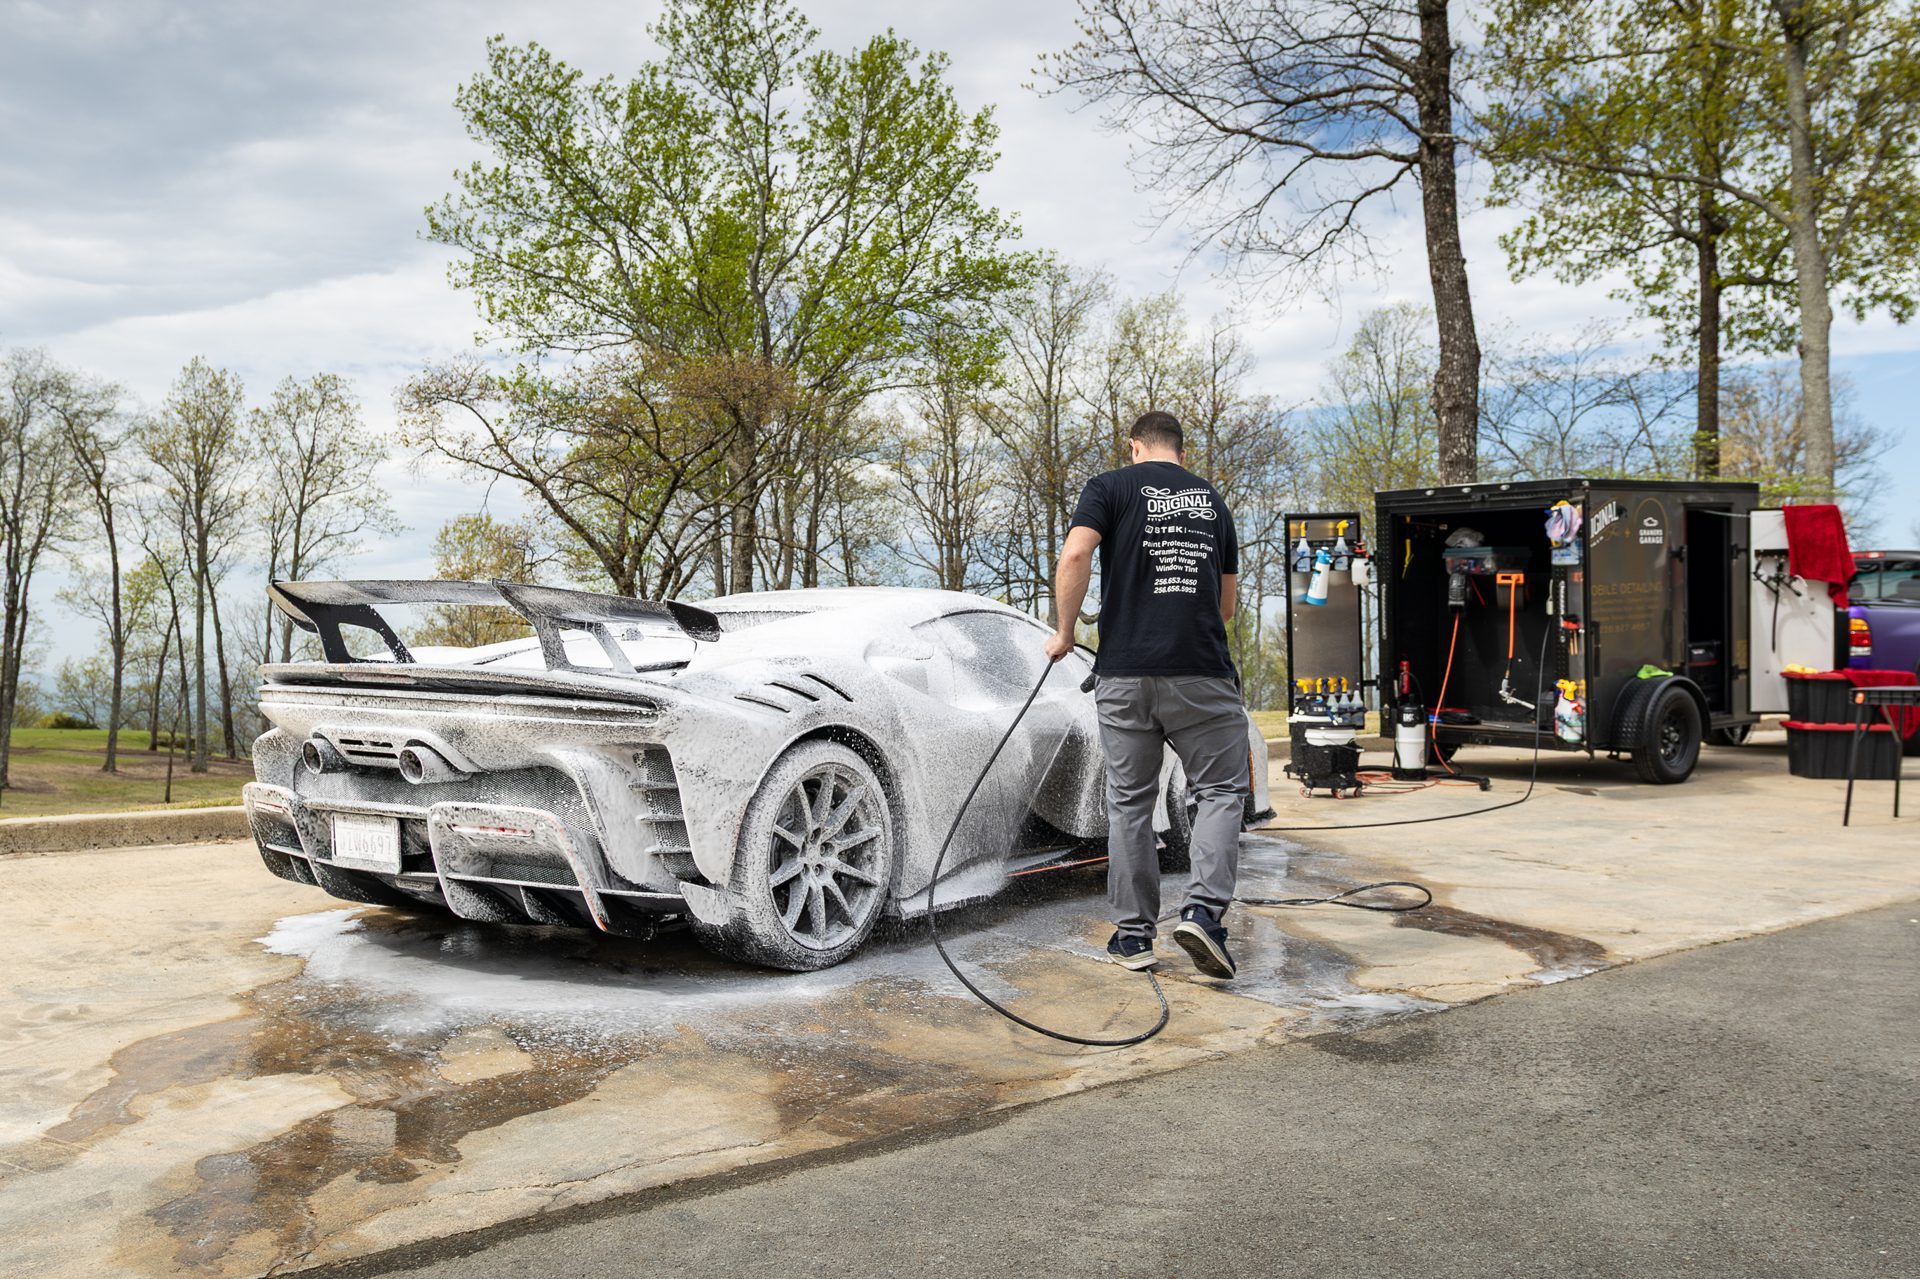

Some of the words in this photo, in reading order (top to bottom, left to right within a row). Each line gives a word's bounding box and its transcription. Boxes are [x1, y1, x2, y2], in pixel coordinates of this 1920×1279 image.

[1147, 495, 1212, 512] ORIGINAL
[1154, 526, 1183, 534] STEK
[1638, 536, 1664, 544] GARAGE
[1162, 540, 1198, 549] Protection
[1200, 543, 1213, 552] Film
[1149, 548, 1178, 556] Ceramic
[1179, 548, 1207, 559] Coating
[1158, 556, 1177, 564] Vinyl
[1178, 556, 1196, 566] Wrap
[1155, 564, 1184, 572] Window
